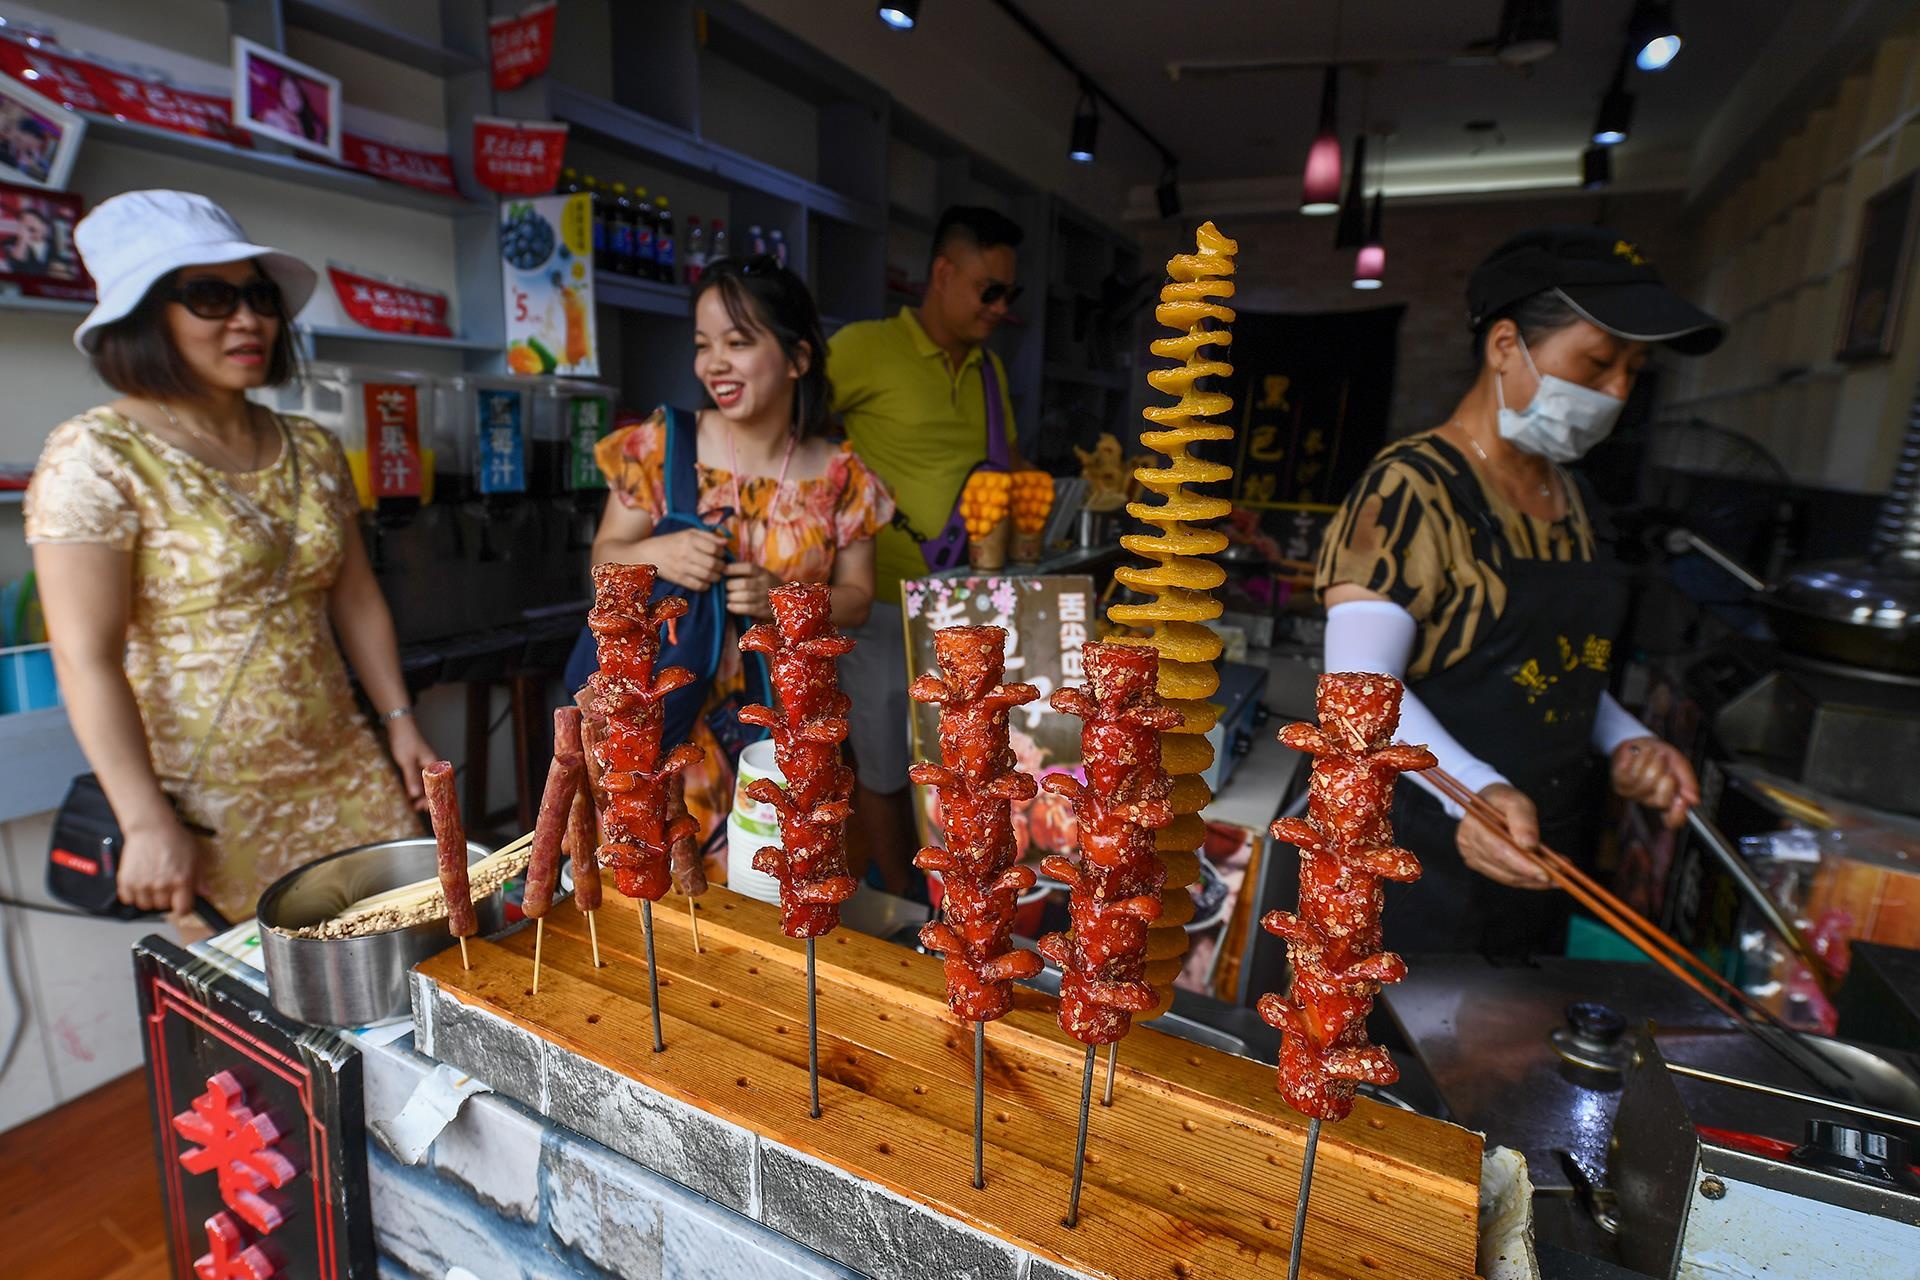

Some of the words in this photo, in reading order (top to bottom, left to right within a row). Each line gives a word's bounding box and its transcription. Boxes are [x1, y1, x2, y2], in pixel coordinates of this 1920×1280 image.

[515, 292, 529, 322] 5
[376, 390, 411, 489] 芒果汁
